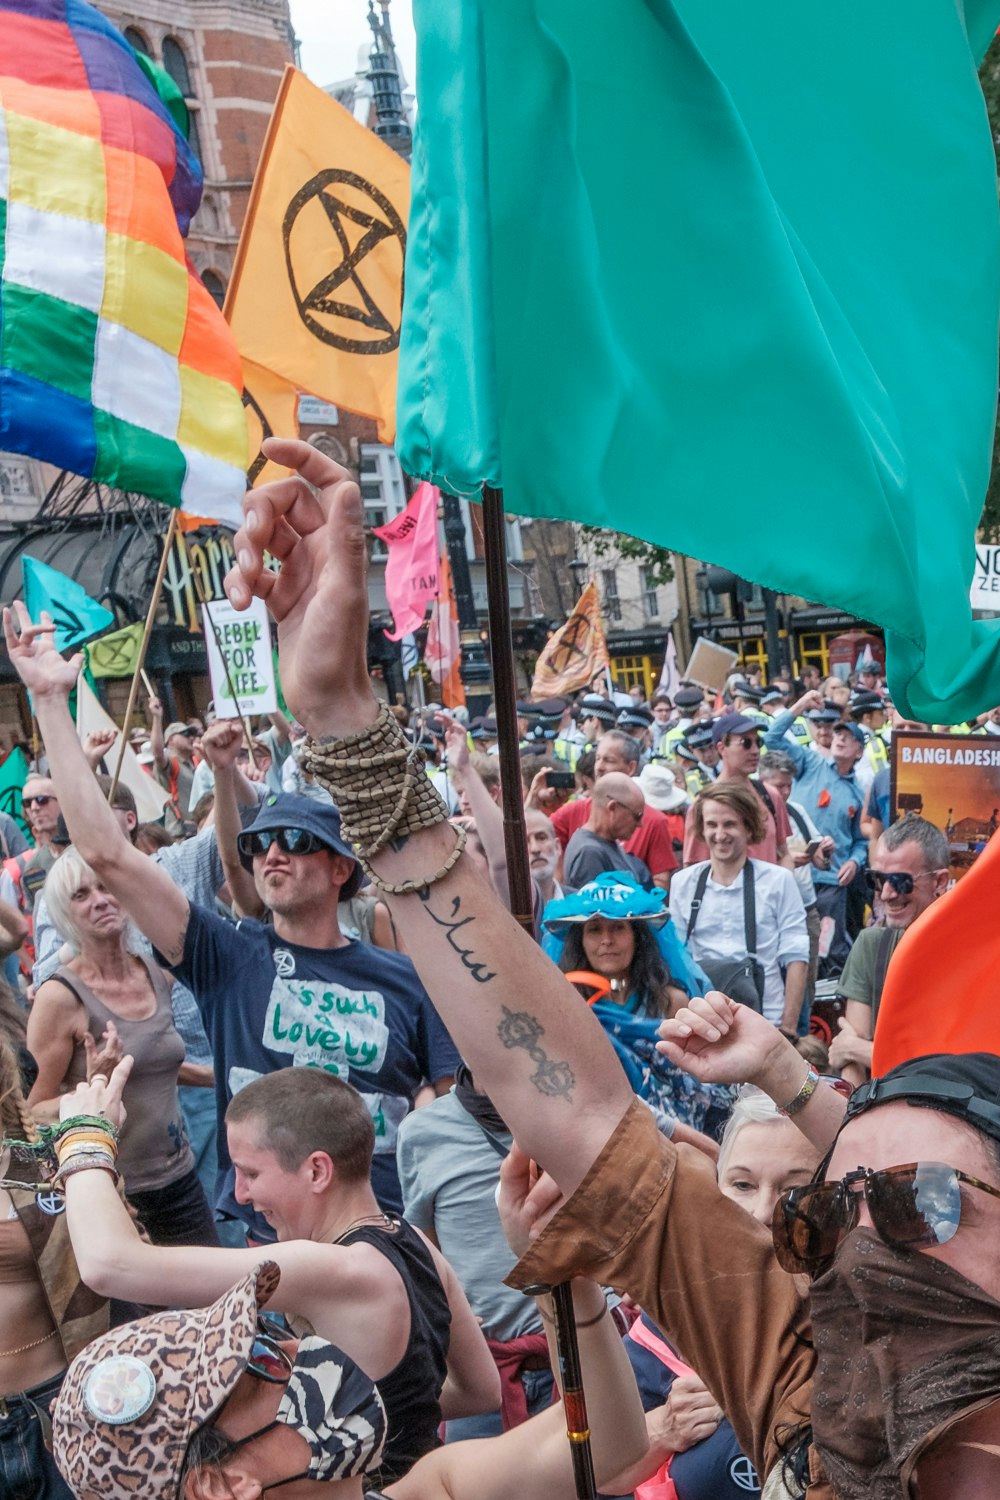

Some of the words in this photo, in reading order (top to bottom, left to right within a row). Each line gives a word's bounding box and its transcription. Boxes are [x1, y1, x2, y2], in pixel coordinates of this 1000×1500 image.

[213, 620, 261, 646] REBEL
[223, 647, 256, 671] FOR
[318, 992, 378, 1019] such
